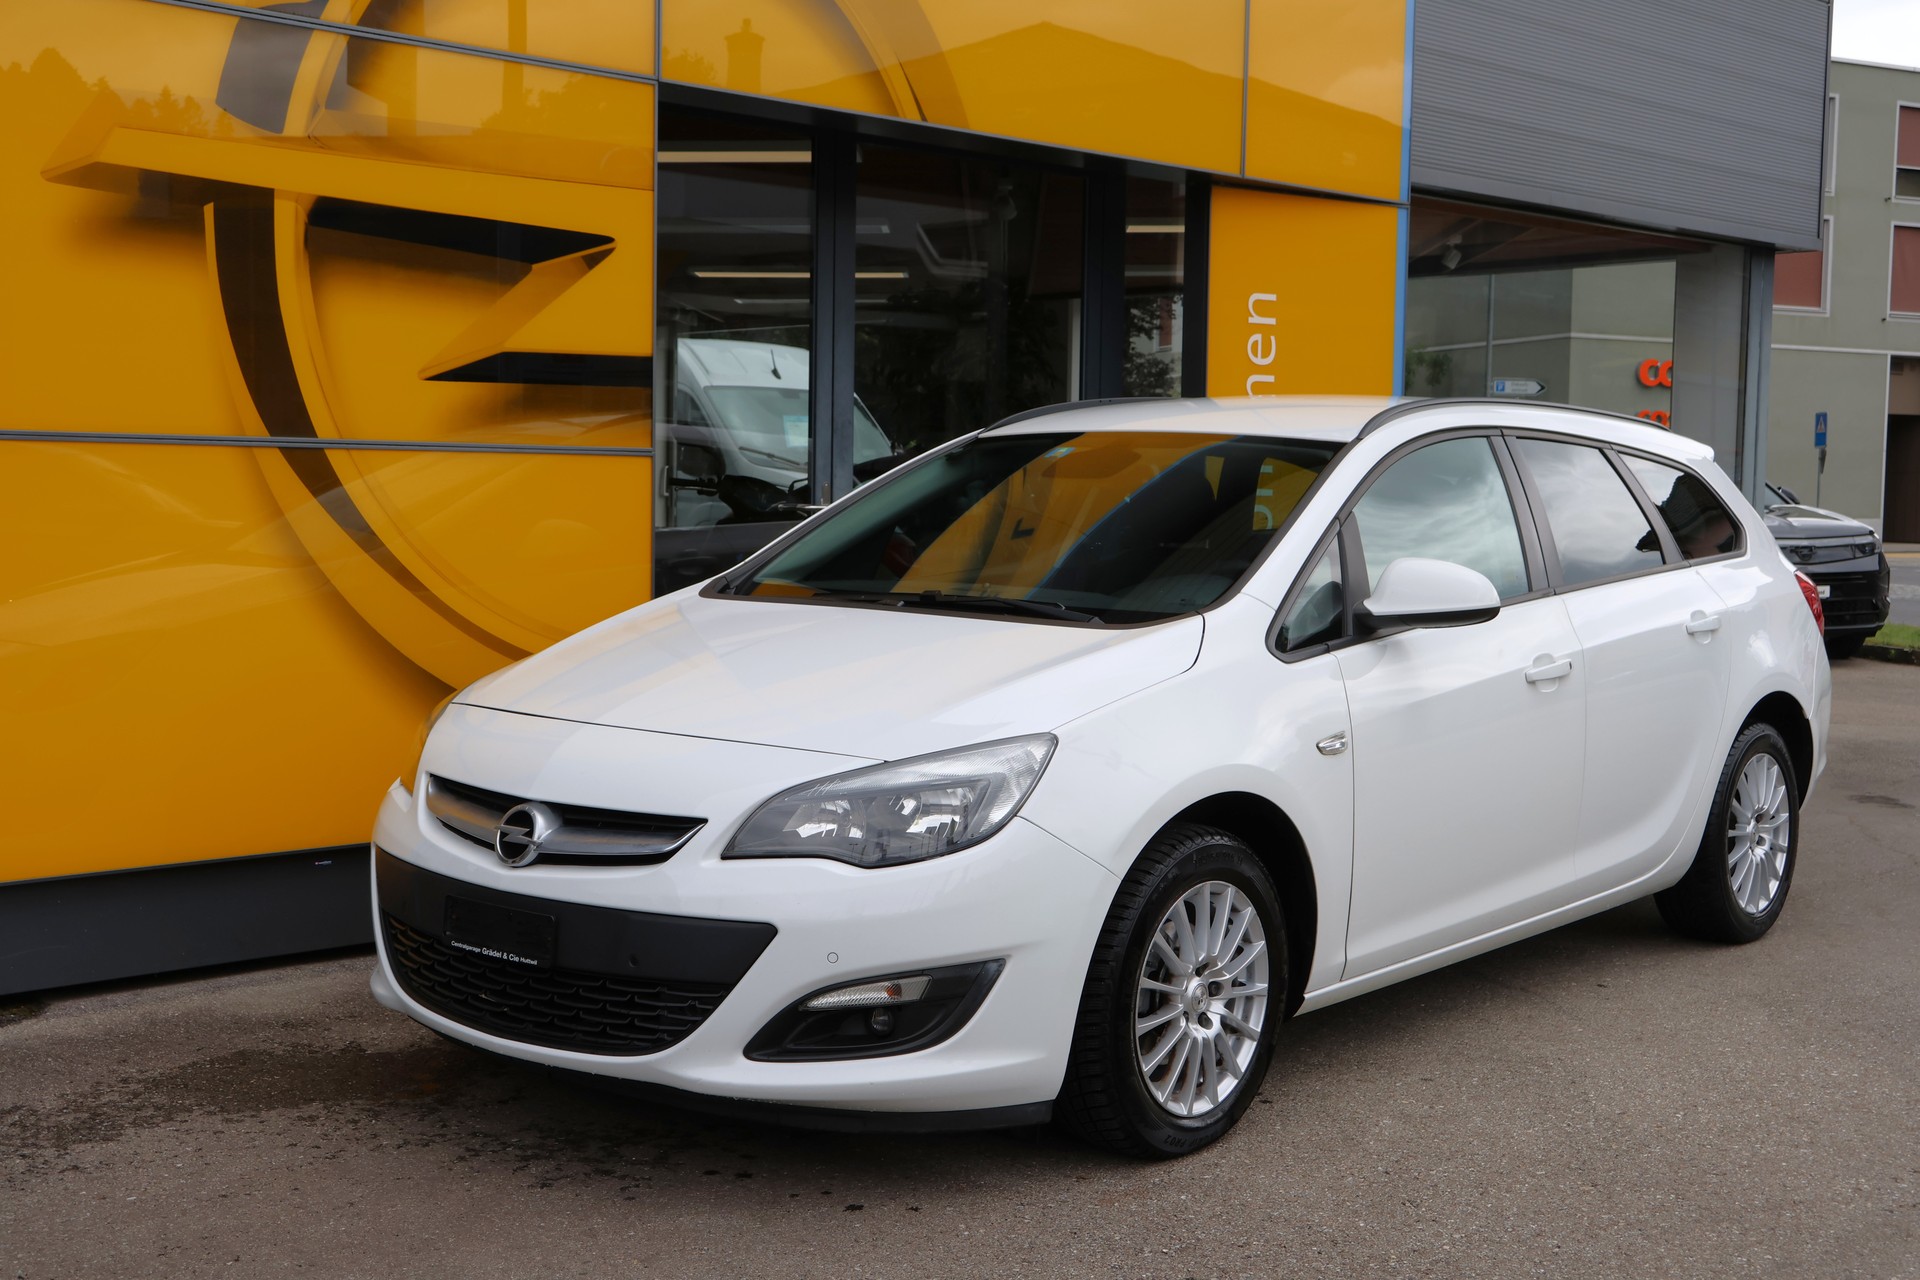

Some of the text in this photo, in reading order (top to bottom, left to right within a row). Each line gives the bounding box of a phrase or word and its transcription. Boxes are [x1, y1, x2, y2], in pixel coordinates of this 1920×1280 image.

[451, 940, 481, 953] Centralgarage
[482, 947, 502, 958] Grädel
[502, 952, 508, 960] &
[508, 953, 519, 962] Cie
